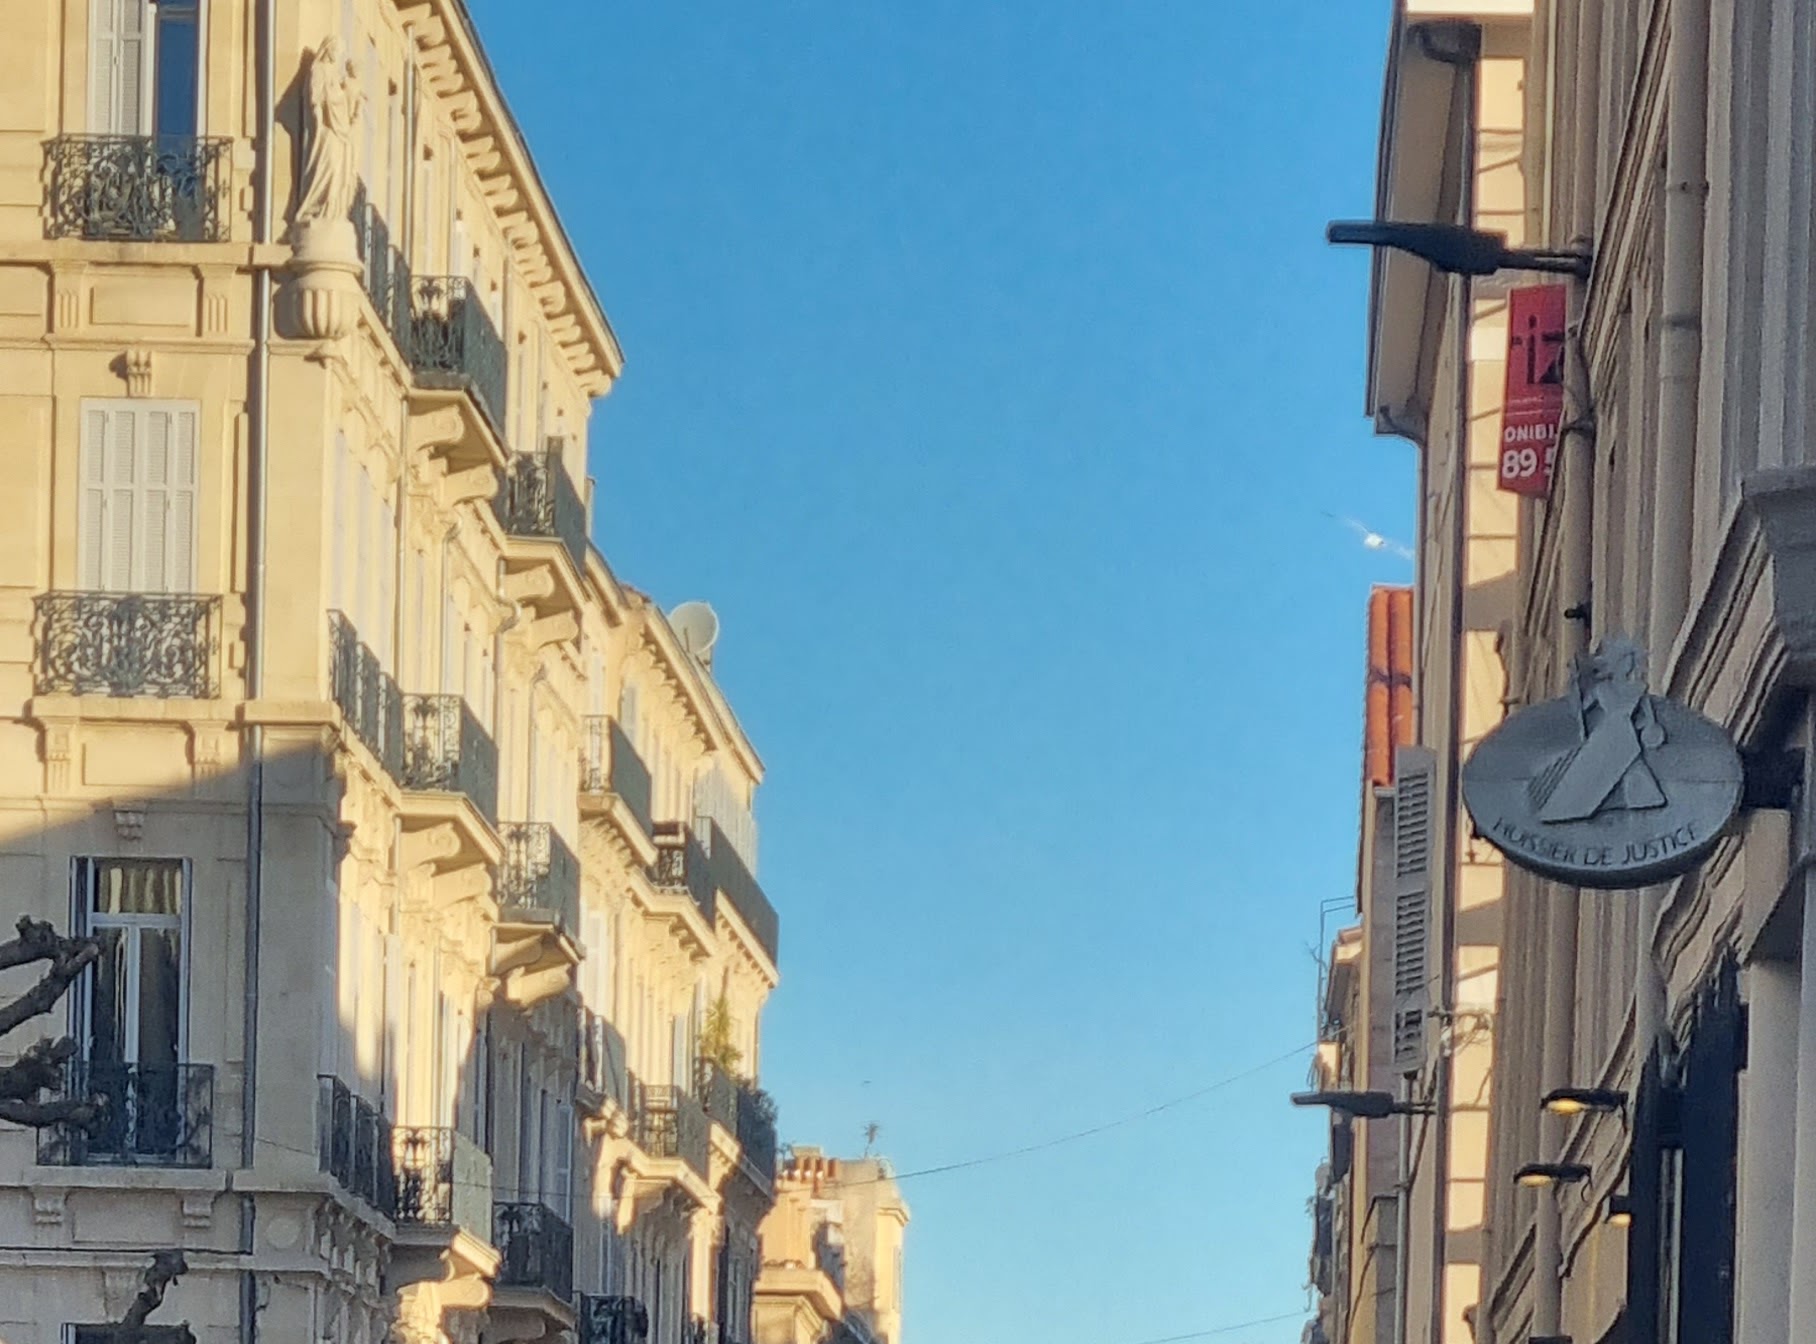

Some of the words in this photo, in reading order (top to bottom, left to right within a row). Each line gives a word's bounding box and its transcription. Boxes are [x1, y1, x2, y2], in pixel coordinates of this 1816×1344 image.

[1502, 447, 1537, 479] 89
[1583, 847, 1614, 866] DE
[1623, 822, 1697, 865] JUSTICE
